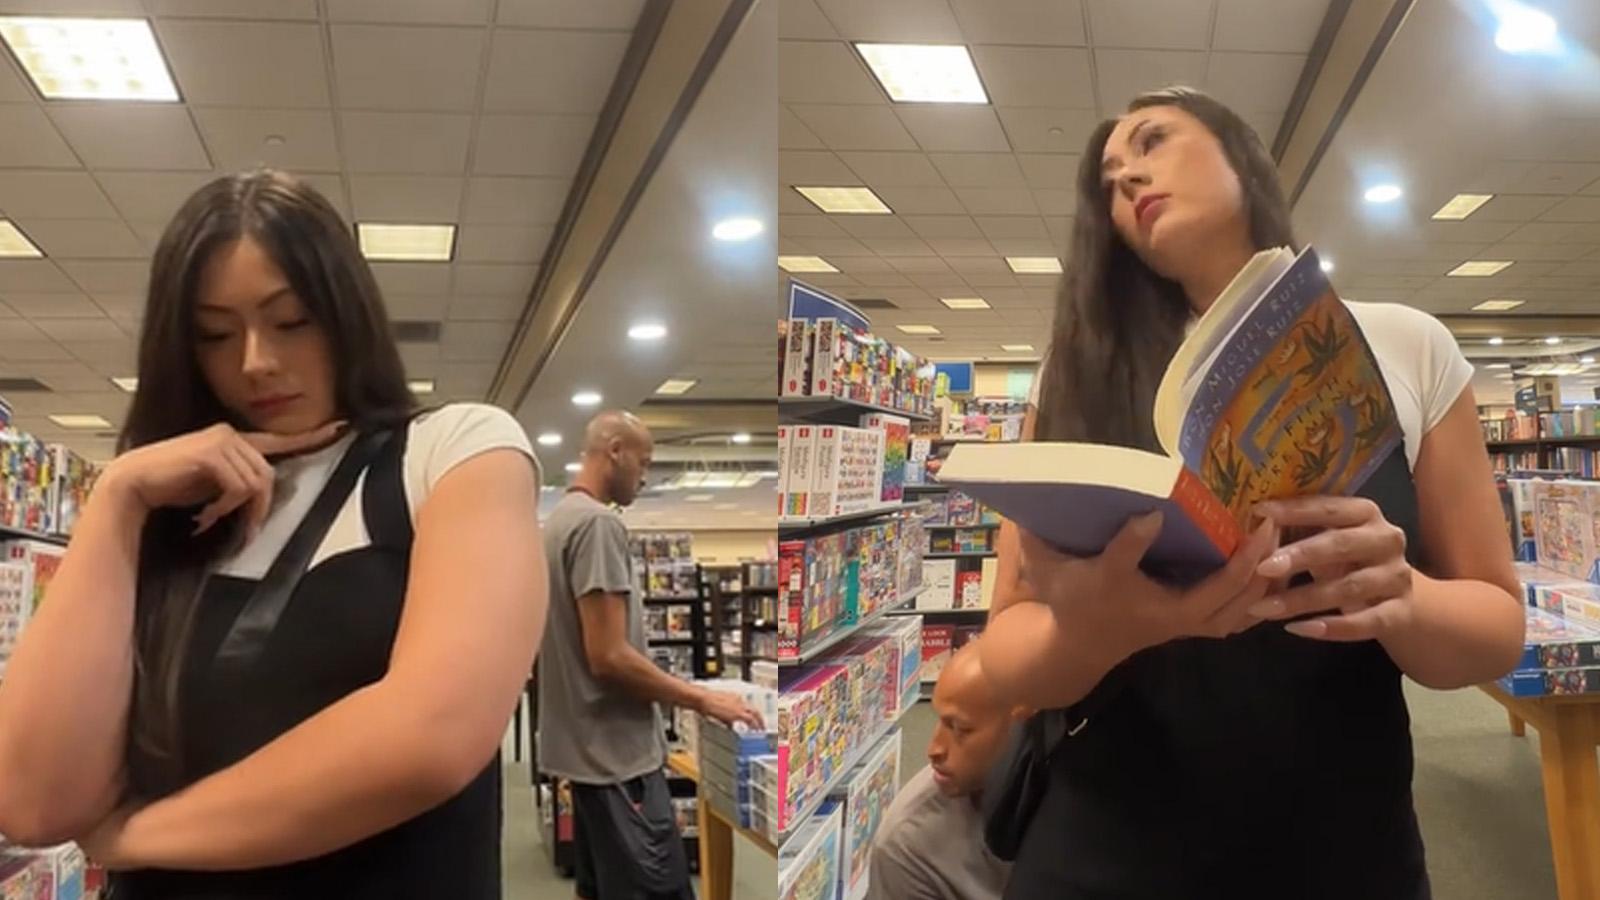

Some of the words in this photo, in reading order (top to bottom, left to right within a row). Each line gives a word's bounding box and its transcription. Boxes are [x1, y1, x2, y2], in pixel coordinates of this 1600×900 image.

[1208, 321, 1265, 392] MIGUEL
[1270, 272, 1306, 312] RUIZ
[1266, 299, 1305, 339] RUIZ
[1283, 376, 1339, 437] FIFTH
